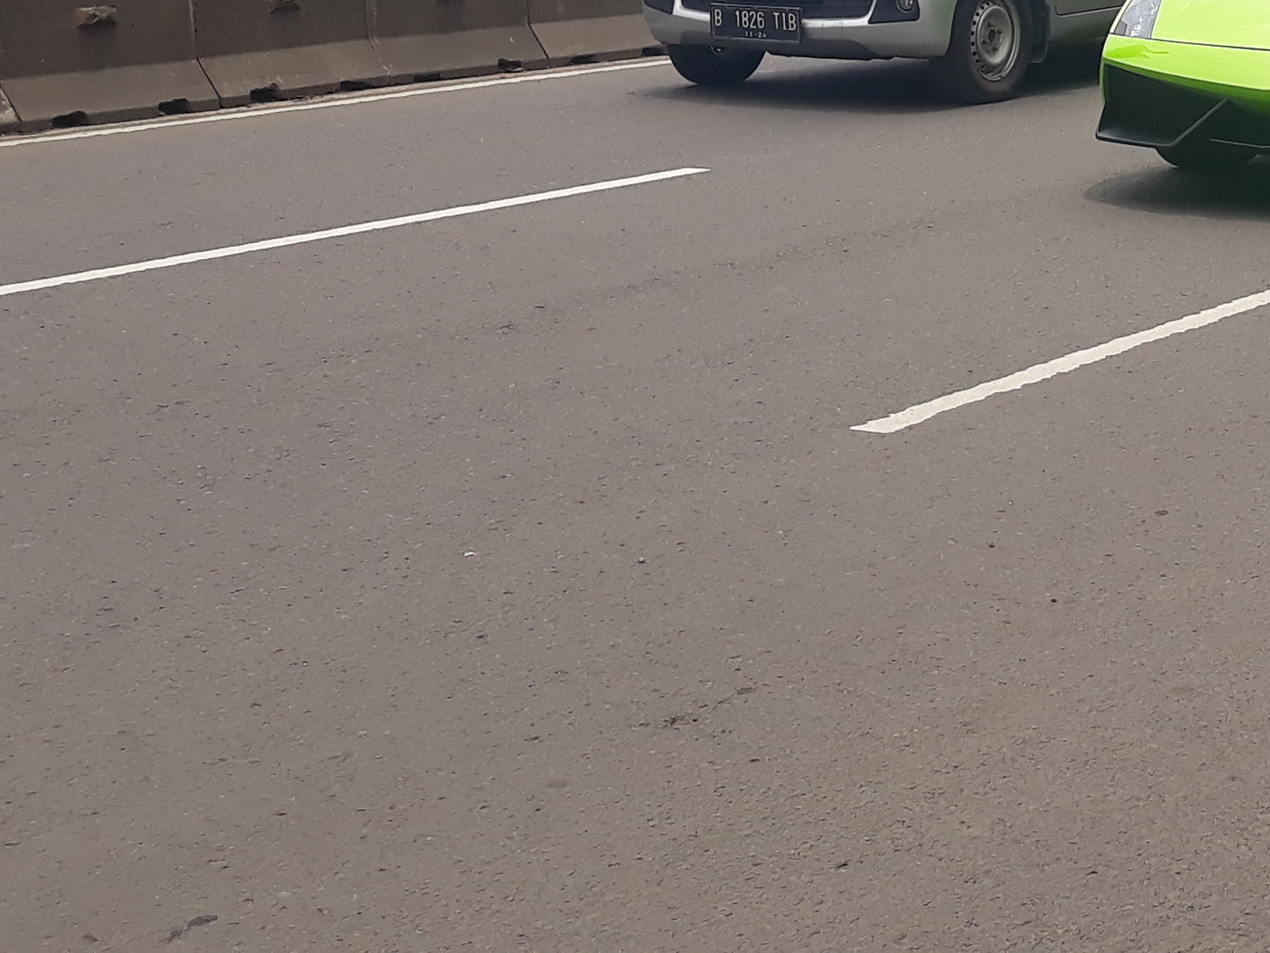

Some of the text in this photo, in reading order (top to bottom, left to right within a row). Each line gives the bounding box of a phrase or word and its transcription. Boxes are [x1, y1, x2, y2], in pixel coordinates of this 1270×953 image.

[714, 9, 797, 31] B 1826 TIB
